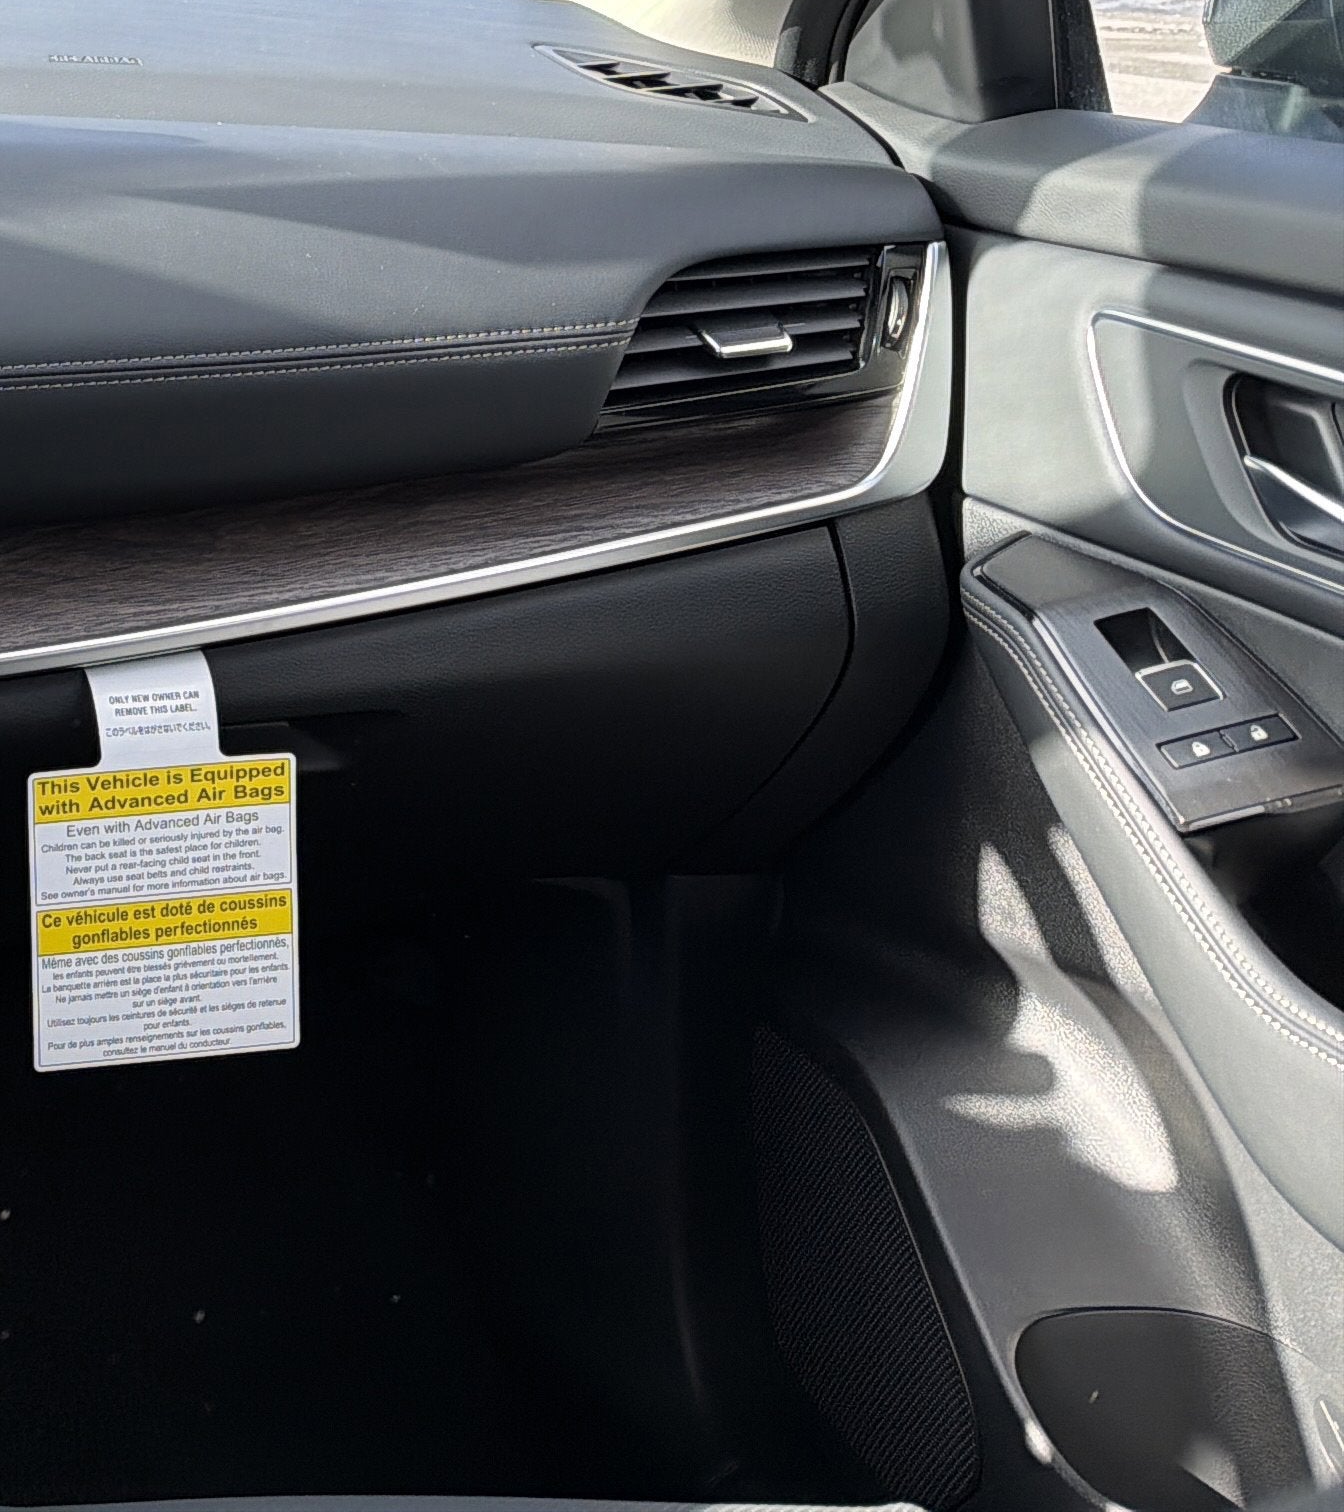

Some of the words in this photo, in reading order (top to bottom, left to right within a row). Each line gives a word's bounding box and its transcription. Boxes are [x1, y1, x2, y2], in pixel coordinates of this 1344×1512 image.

[108, 695, 129, 705] ONLY
[131, 694, 150, 703] NEW
[151, 691, 181, 701] OWNER
[182, 690, 200, 700] CAN
[114, 706, 147, 716] REMOVE
[150, 704, 168, 714] THIS
[169, 703, 197, 713] LABEL.
[37, 779, 80, 795] This
[87, 773, 159, 791] Vehicle
[166, 770, 183, 785] is
[190, 763, 285, 783] Equipped
[39, 799, 80, 815] with
[88, 791, 188, 811] Advanced
[197, 788, 223, 802] Air
[233, 785, 284, 800] Bags
[66, 824, 100, 837] Even
[103, 821, 131, 834] with
[134, 816, 200, 831] Advanced
[203, 814, 220, 825] Air
[225, 811, 259, 825] Bags
[40, 843, 78, 853] Children
[80, 841, 97, 850] can
[98, 839, 111, 848] be
[112, 837, 136, 846] killed
[137, 837, 147, 845] or
[149, 833, 188, 844] seriously
[190, 830, 220, 841] injured
[222, 829, 233, 839] by
[235, 828, 249, 836] the
[251, 826, 262, 835] air
[41, 913, 61, 928] Ce
[66, 908, 128, 925] véhicule
[133, 905, 155, 920] est
[160, 901, 192, 917] doté
[197, 899, 215, 914] de
[219, 895, 286, 912] coussins
[72, 927, 150, 949] gonflables
[154, 918, 257, 940] perfectionnés
[74, 955, 99, 967] avec
[100, 952, 119, 964] des
[121, 949, 164, 962] coussins
[166, 944, 217, 961] gonflables
